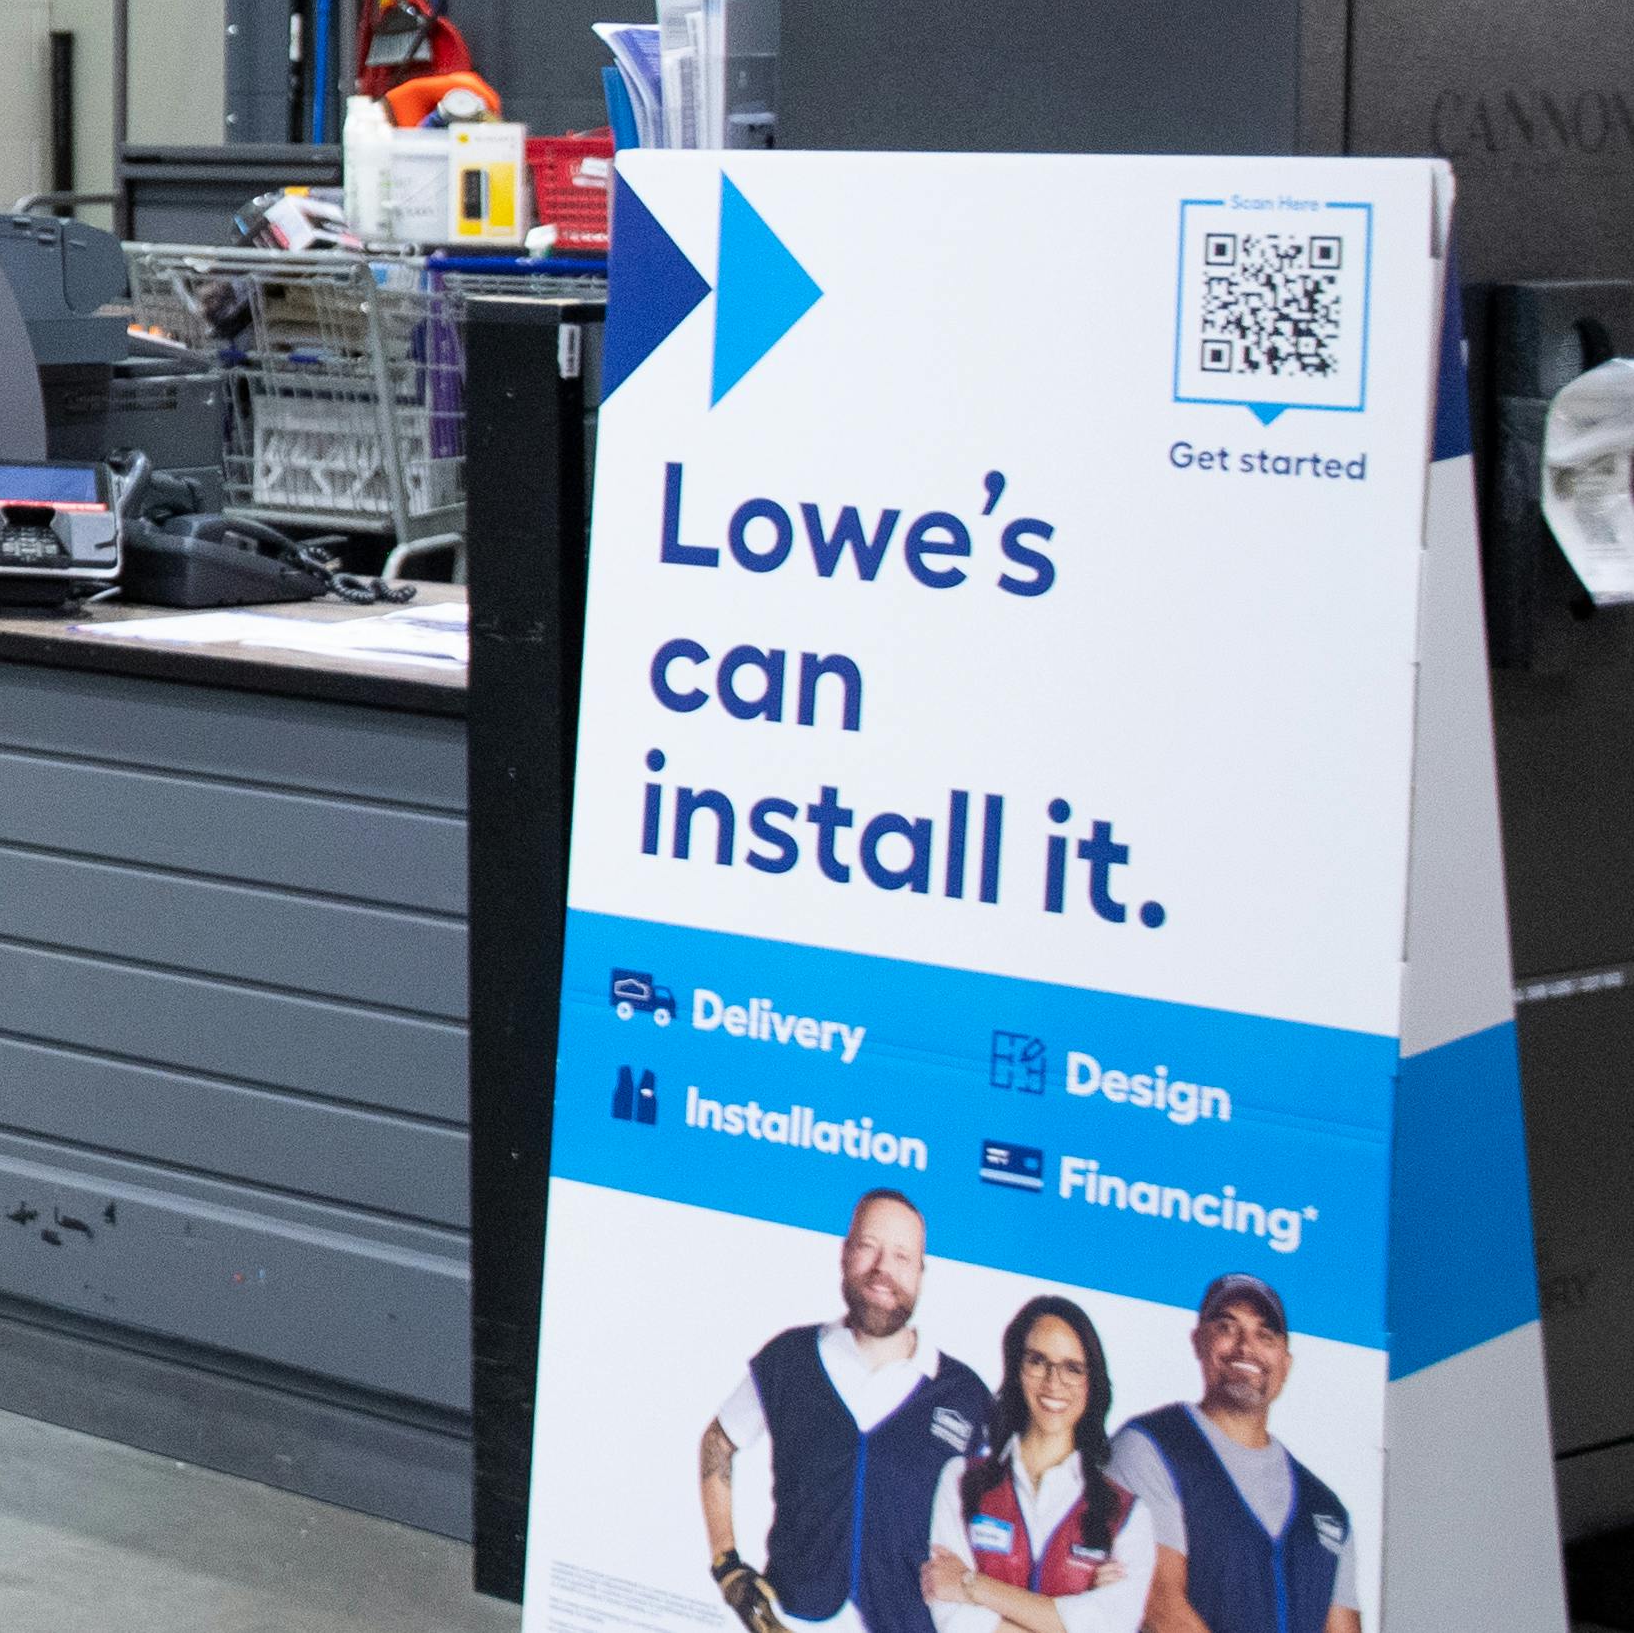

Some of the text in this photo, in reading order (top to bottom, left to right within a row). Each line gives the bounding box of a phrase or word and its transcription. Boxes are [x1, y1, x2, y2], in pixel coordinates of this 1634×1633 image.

[1230, 194, 1320, 211] Scan Here
[1169, 441, 1368, 481] Get started
[660, 461, 1056, 598] Lowe's
[651, 637, 863, 732] can
[641, 748, 1167, 929] install it.
[691, 987, 866, 1064] Delivery
[685, 1085, 929, 1172] Installation
[1065, 1050, 1232, 1126] Design
